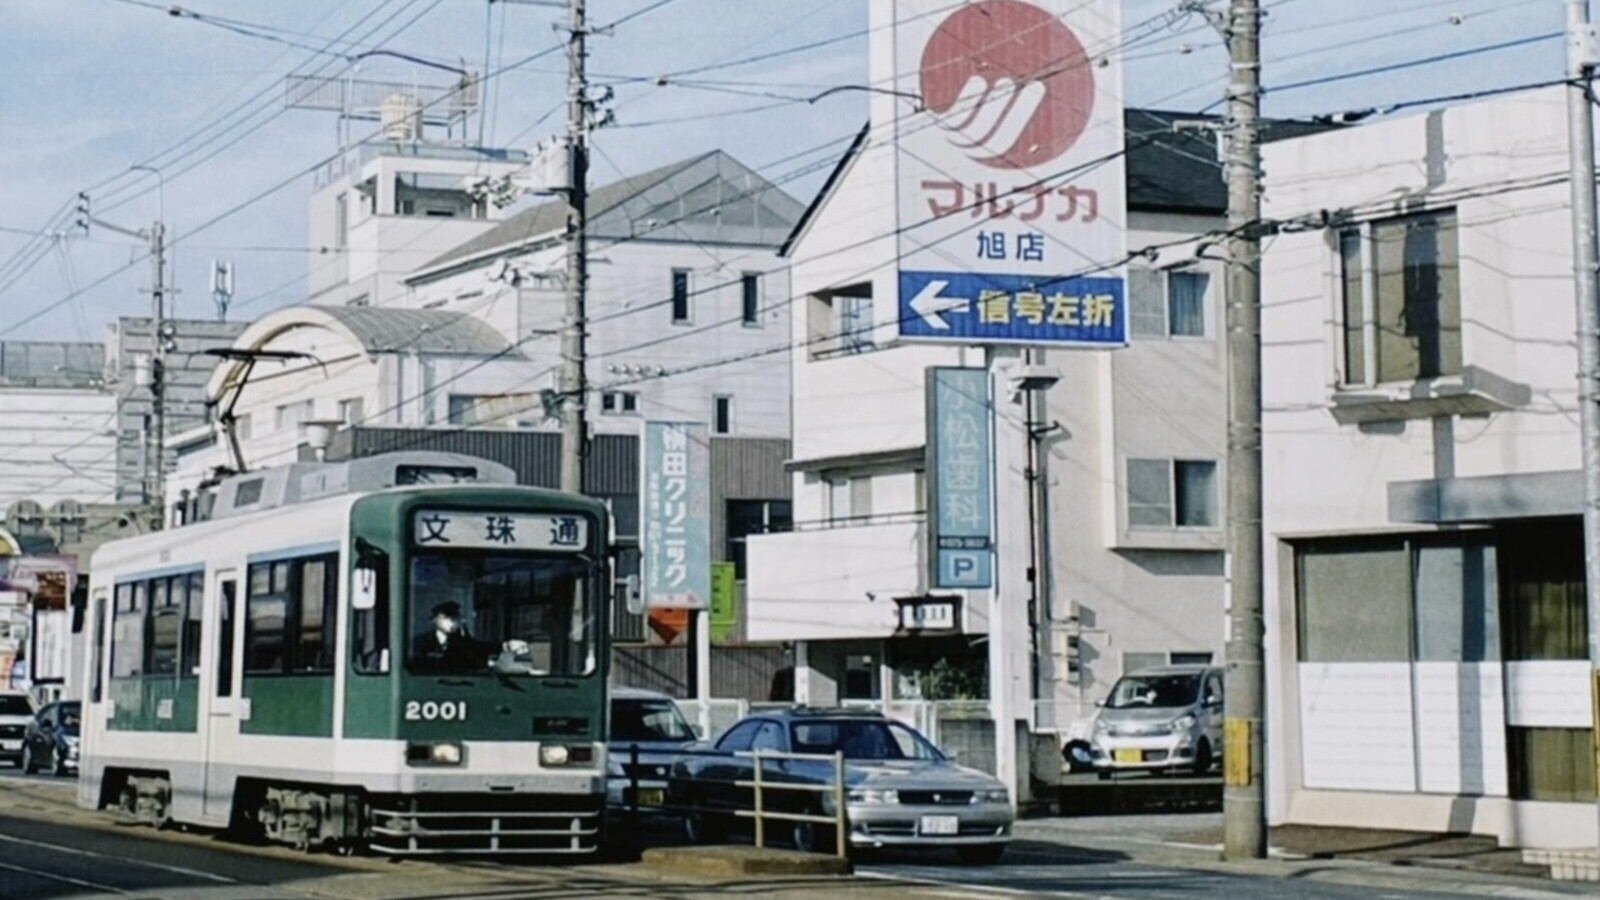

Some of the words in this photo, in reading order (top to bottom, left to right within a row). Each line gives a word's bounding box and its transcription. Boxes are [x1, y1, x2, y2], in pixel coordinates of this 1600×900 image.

[921, 180, 1098, 222] マルナカ
[977, 230, 1045, 262] 旭店
[977, 289, 1115, 328] 信号左折
[943, 375, 982, 529] 小松歯科
[420, 513, 580, 546] 文珠通
[953, 557, 974, 578] P
[405, 700, 467, 720] 2001
